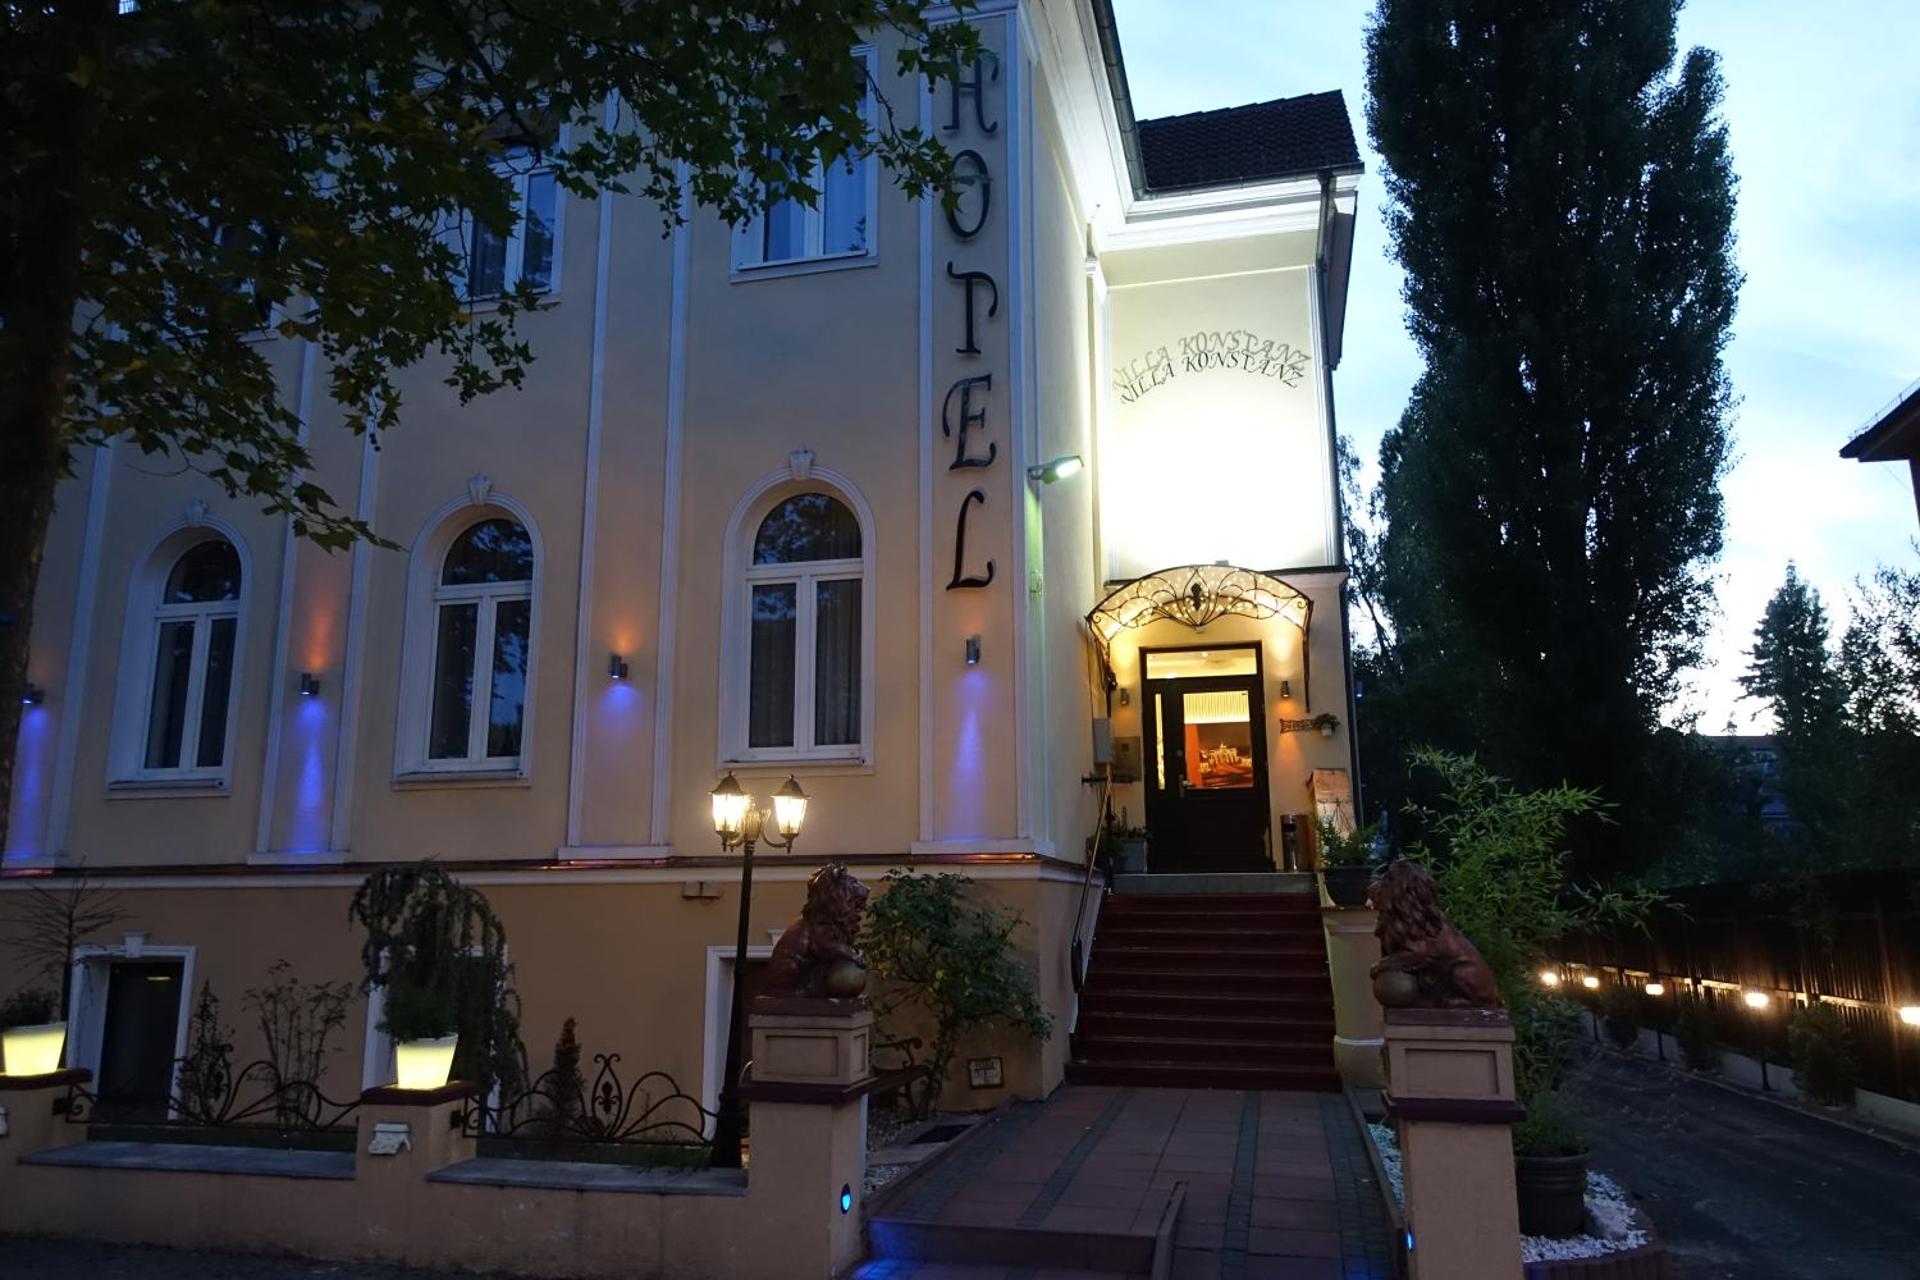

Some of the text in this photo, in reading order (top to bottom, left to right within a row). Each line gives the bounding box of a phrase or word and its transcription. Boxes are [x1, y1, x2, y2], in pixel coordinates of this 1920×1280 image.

[942, 48, 998, 590] HOTEL
[1120, 350, 1304, 404] VILLA KONSTANZ
